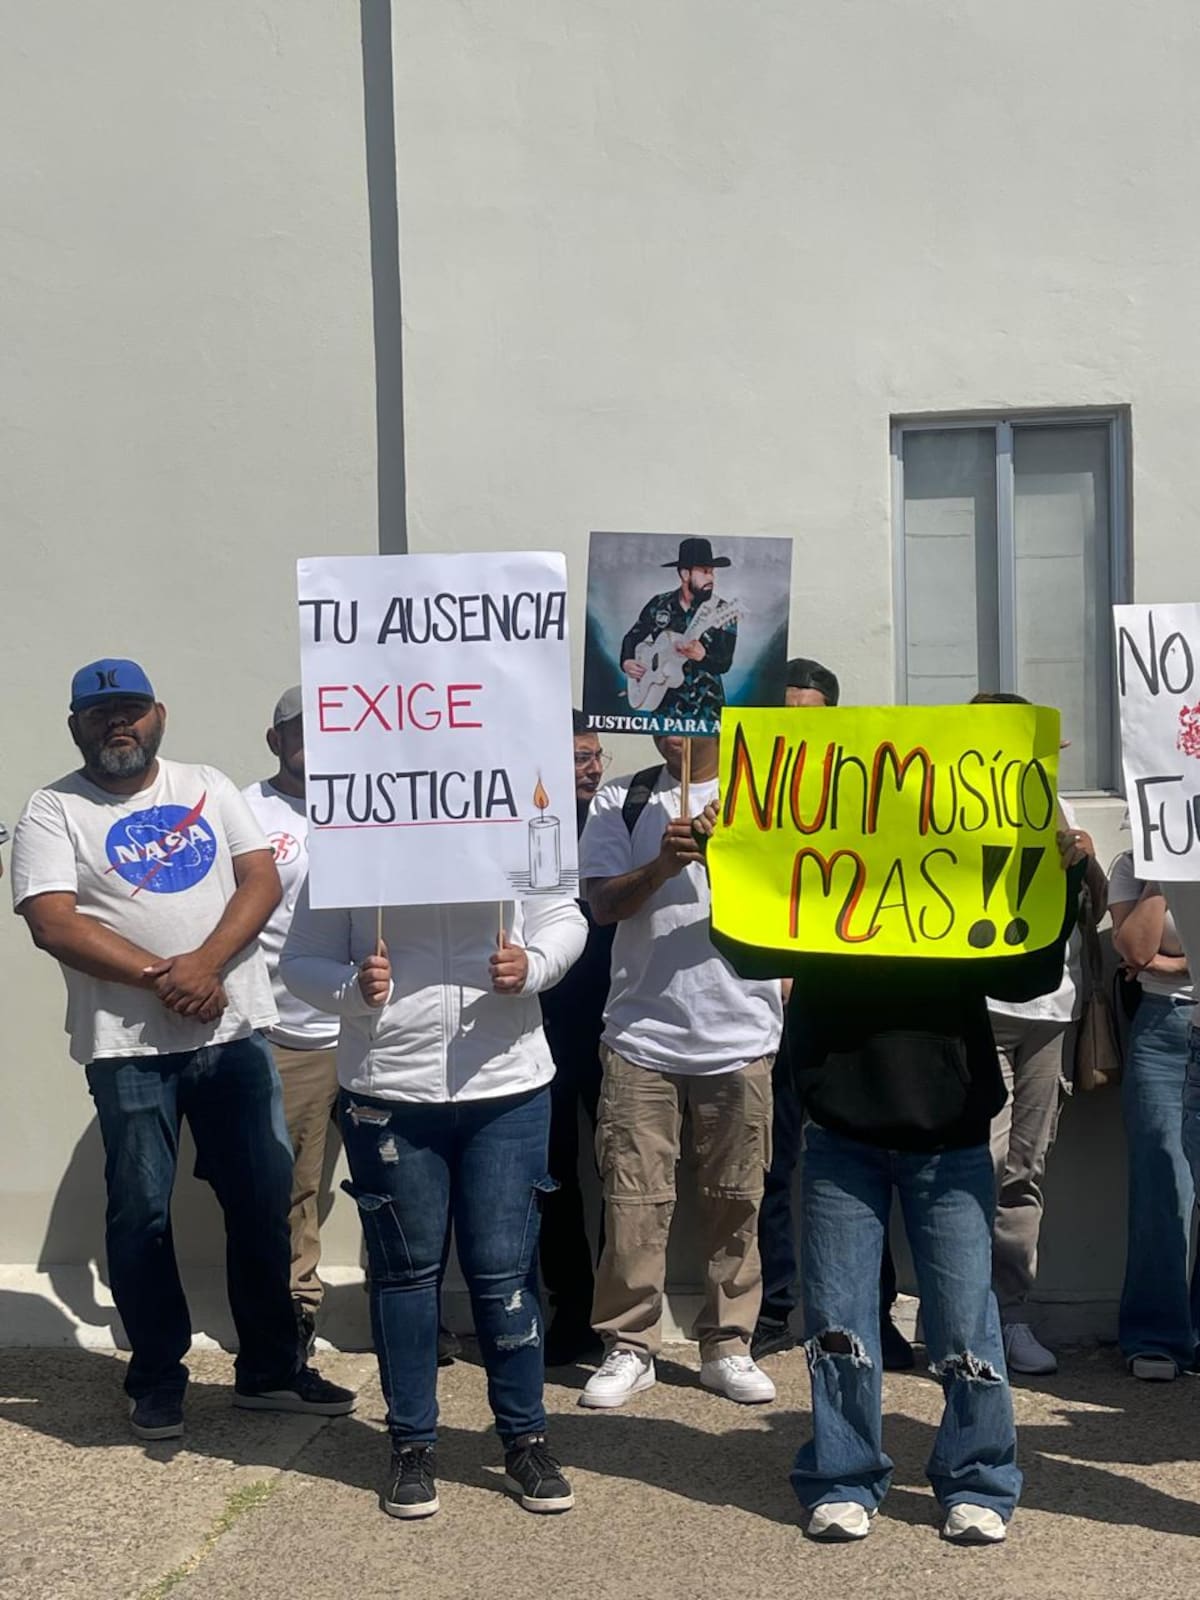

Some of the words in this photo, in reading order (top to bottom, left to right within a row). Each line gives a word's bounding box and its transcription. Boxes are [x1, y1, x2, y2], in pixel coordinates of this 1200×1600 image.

[299, 600, 358, 644] TU
[377, 592, 567, 644] AUSENCIA
[1119, 610, 1194, 696] NO
[318, 683, 483, 731] EXIGE
[586, 715, 660, 731] JUSTICIA
[663, 718, 708, 733] PARA
[309, 769, 518, 825] JUSTICIA
[113, 824, 213, 865] NASA
